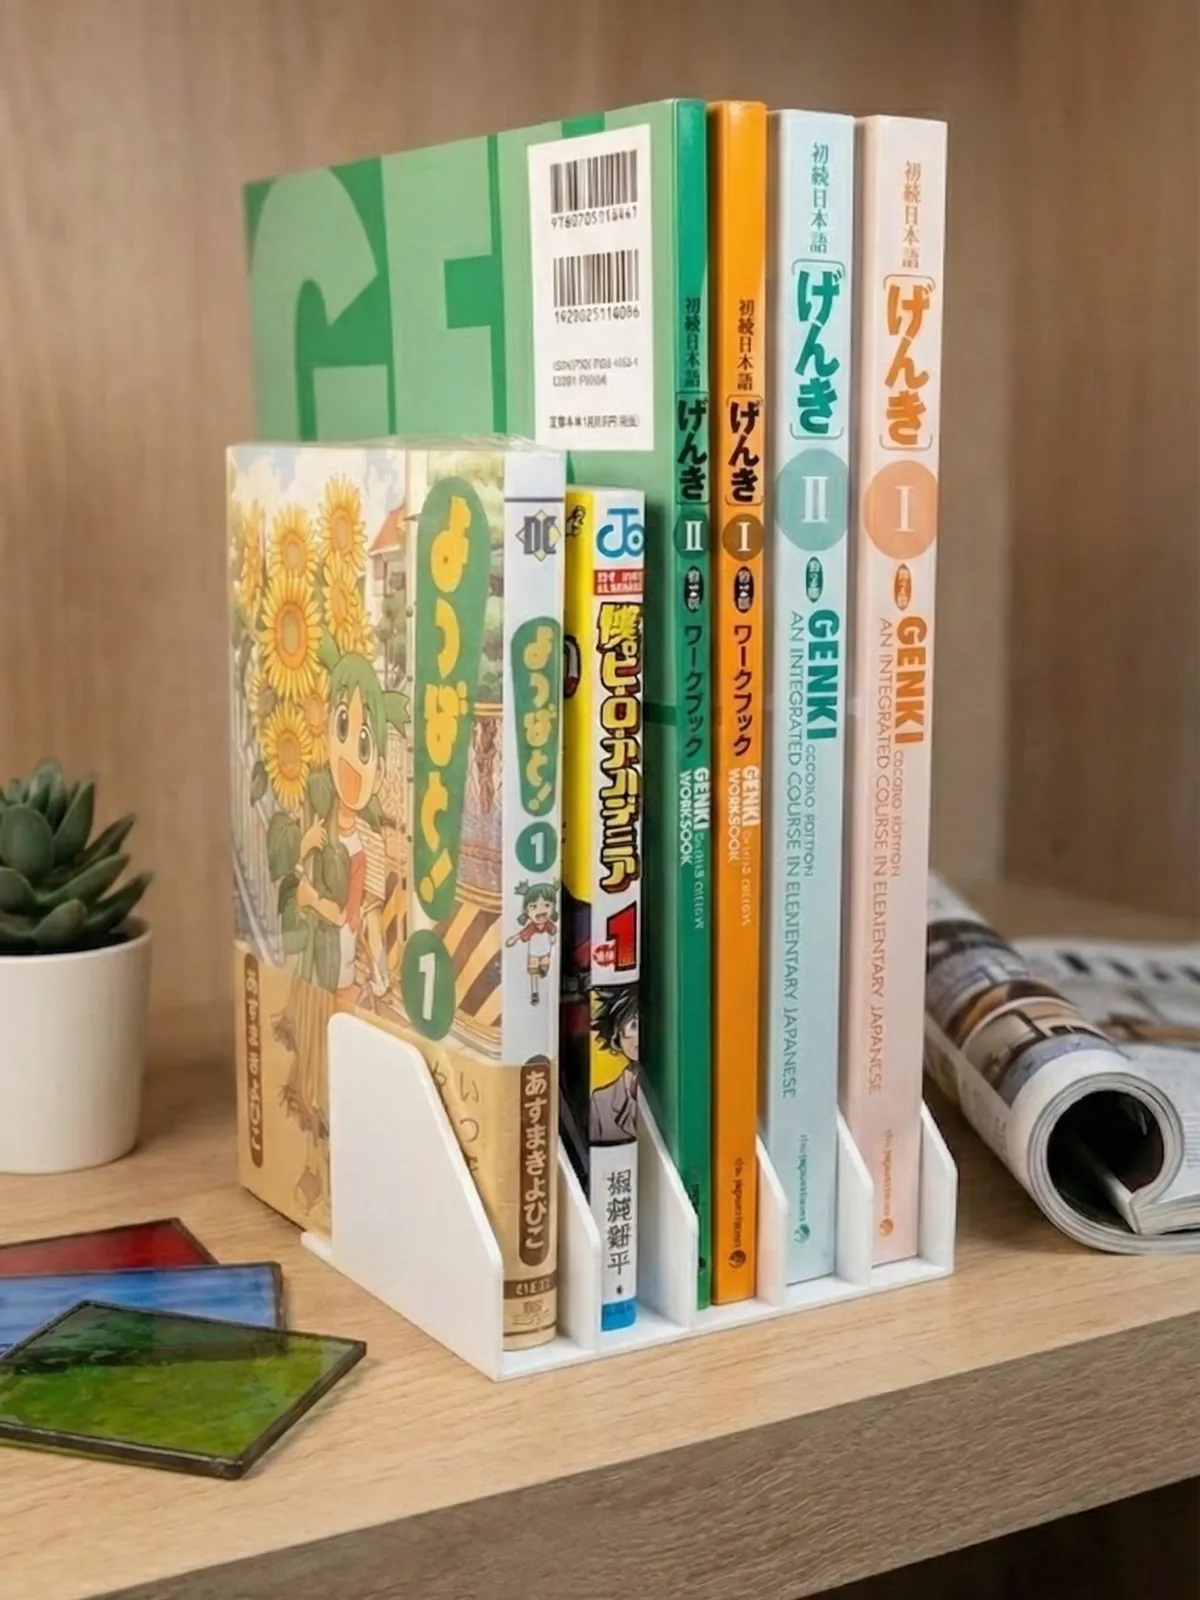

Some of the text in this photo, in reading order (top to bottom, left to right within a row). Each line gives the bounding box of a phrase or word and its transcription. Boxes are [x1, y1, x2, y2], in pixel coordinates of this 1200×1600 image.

[807, 608, 840, 740] GENKI
[895, 616, 927, 744] GENKI
[694, 766, 710, 830] GENKI
[742, 764, 761, 827] GENKI
[530, 832, 545, 865] 1
[783, 611, 804, 1098] AN INTEGRATED COURSE IN ELEMENTARY JAPANESE
[869, 618, 892, 1094] AN INTEGRATED COURSE IN ELEMENTARY JAPANESE
[606, 900, 637, 972] 1
[418, 952, 436, 1021] 1
